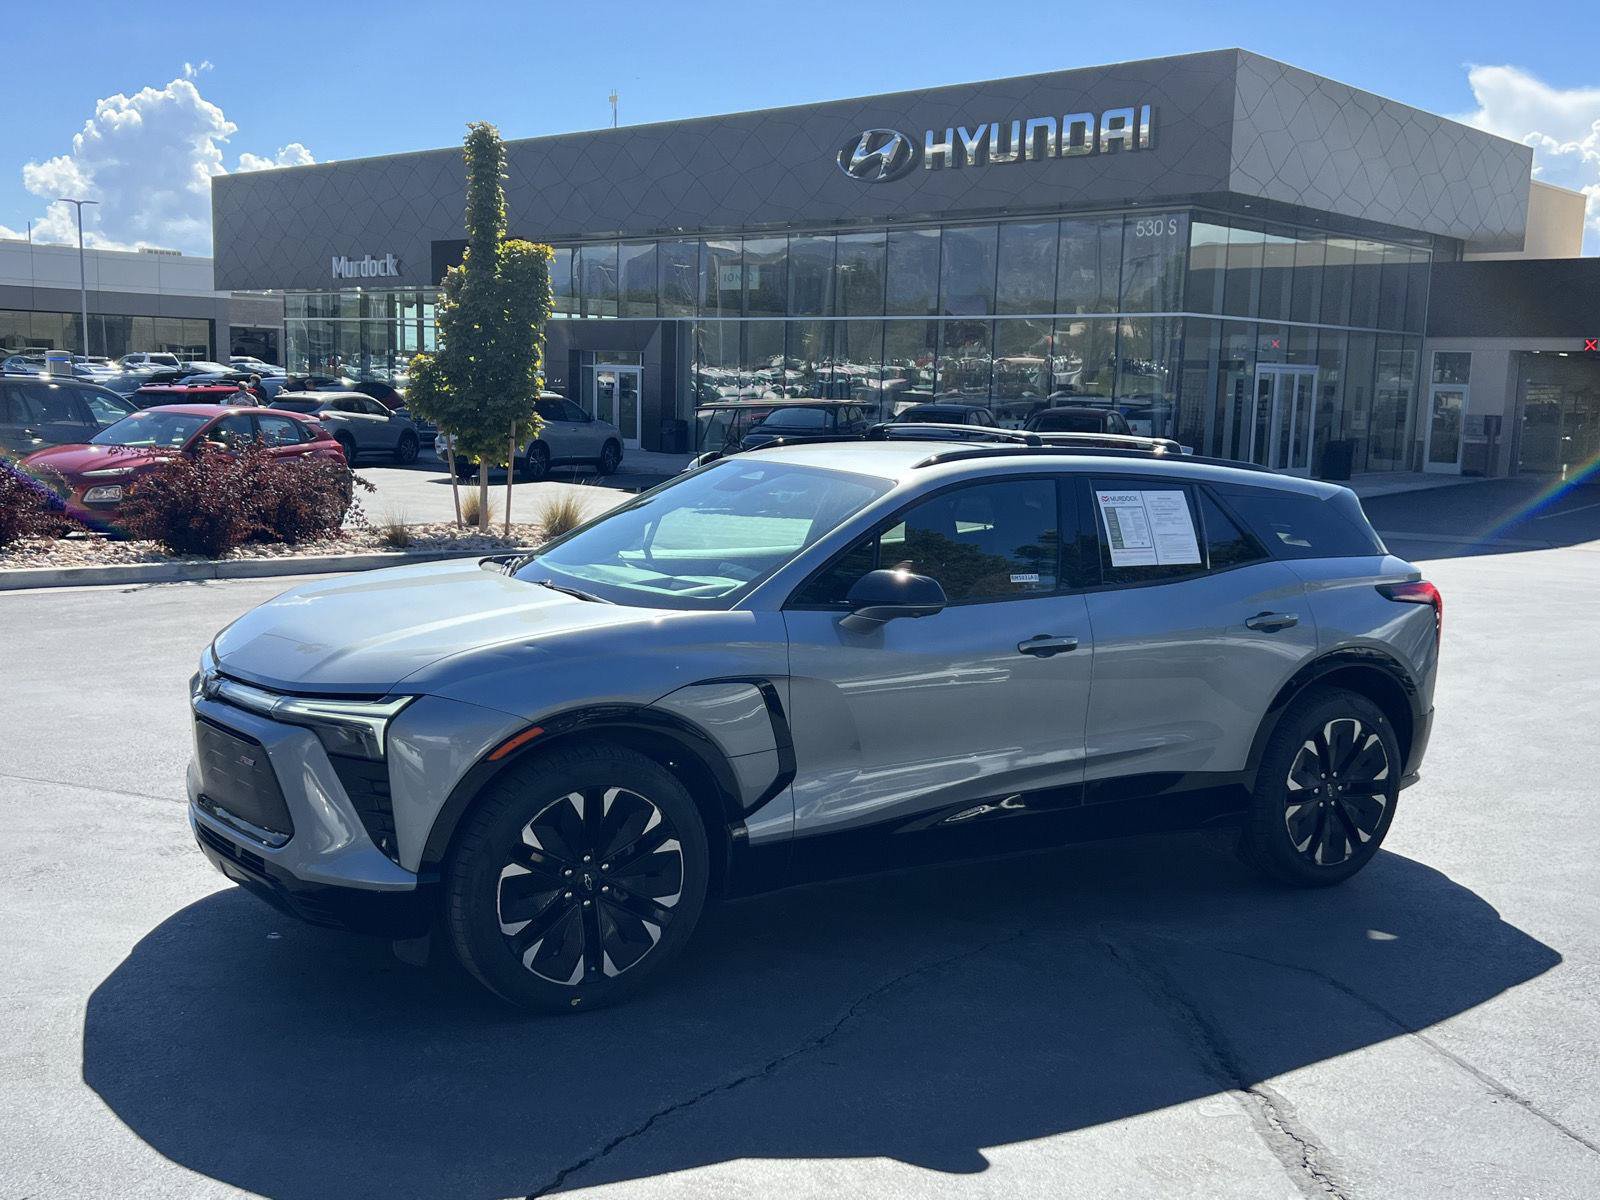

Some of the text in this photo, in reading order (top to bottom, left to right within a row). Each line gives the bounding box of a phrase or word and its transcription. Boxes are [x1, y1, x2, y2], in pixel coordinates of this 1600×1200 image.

[924, 104, 1151, 170] HYUNDAI
[1136, 218, 1177, 237] 530 S
[331, 253, 399, 279] Murdock
